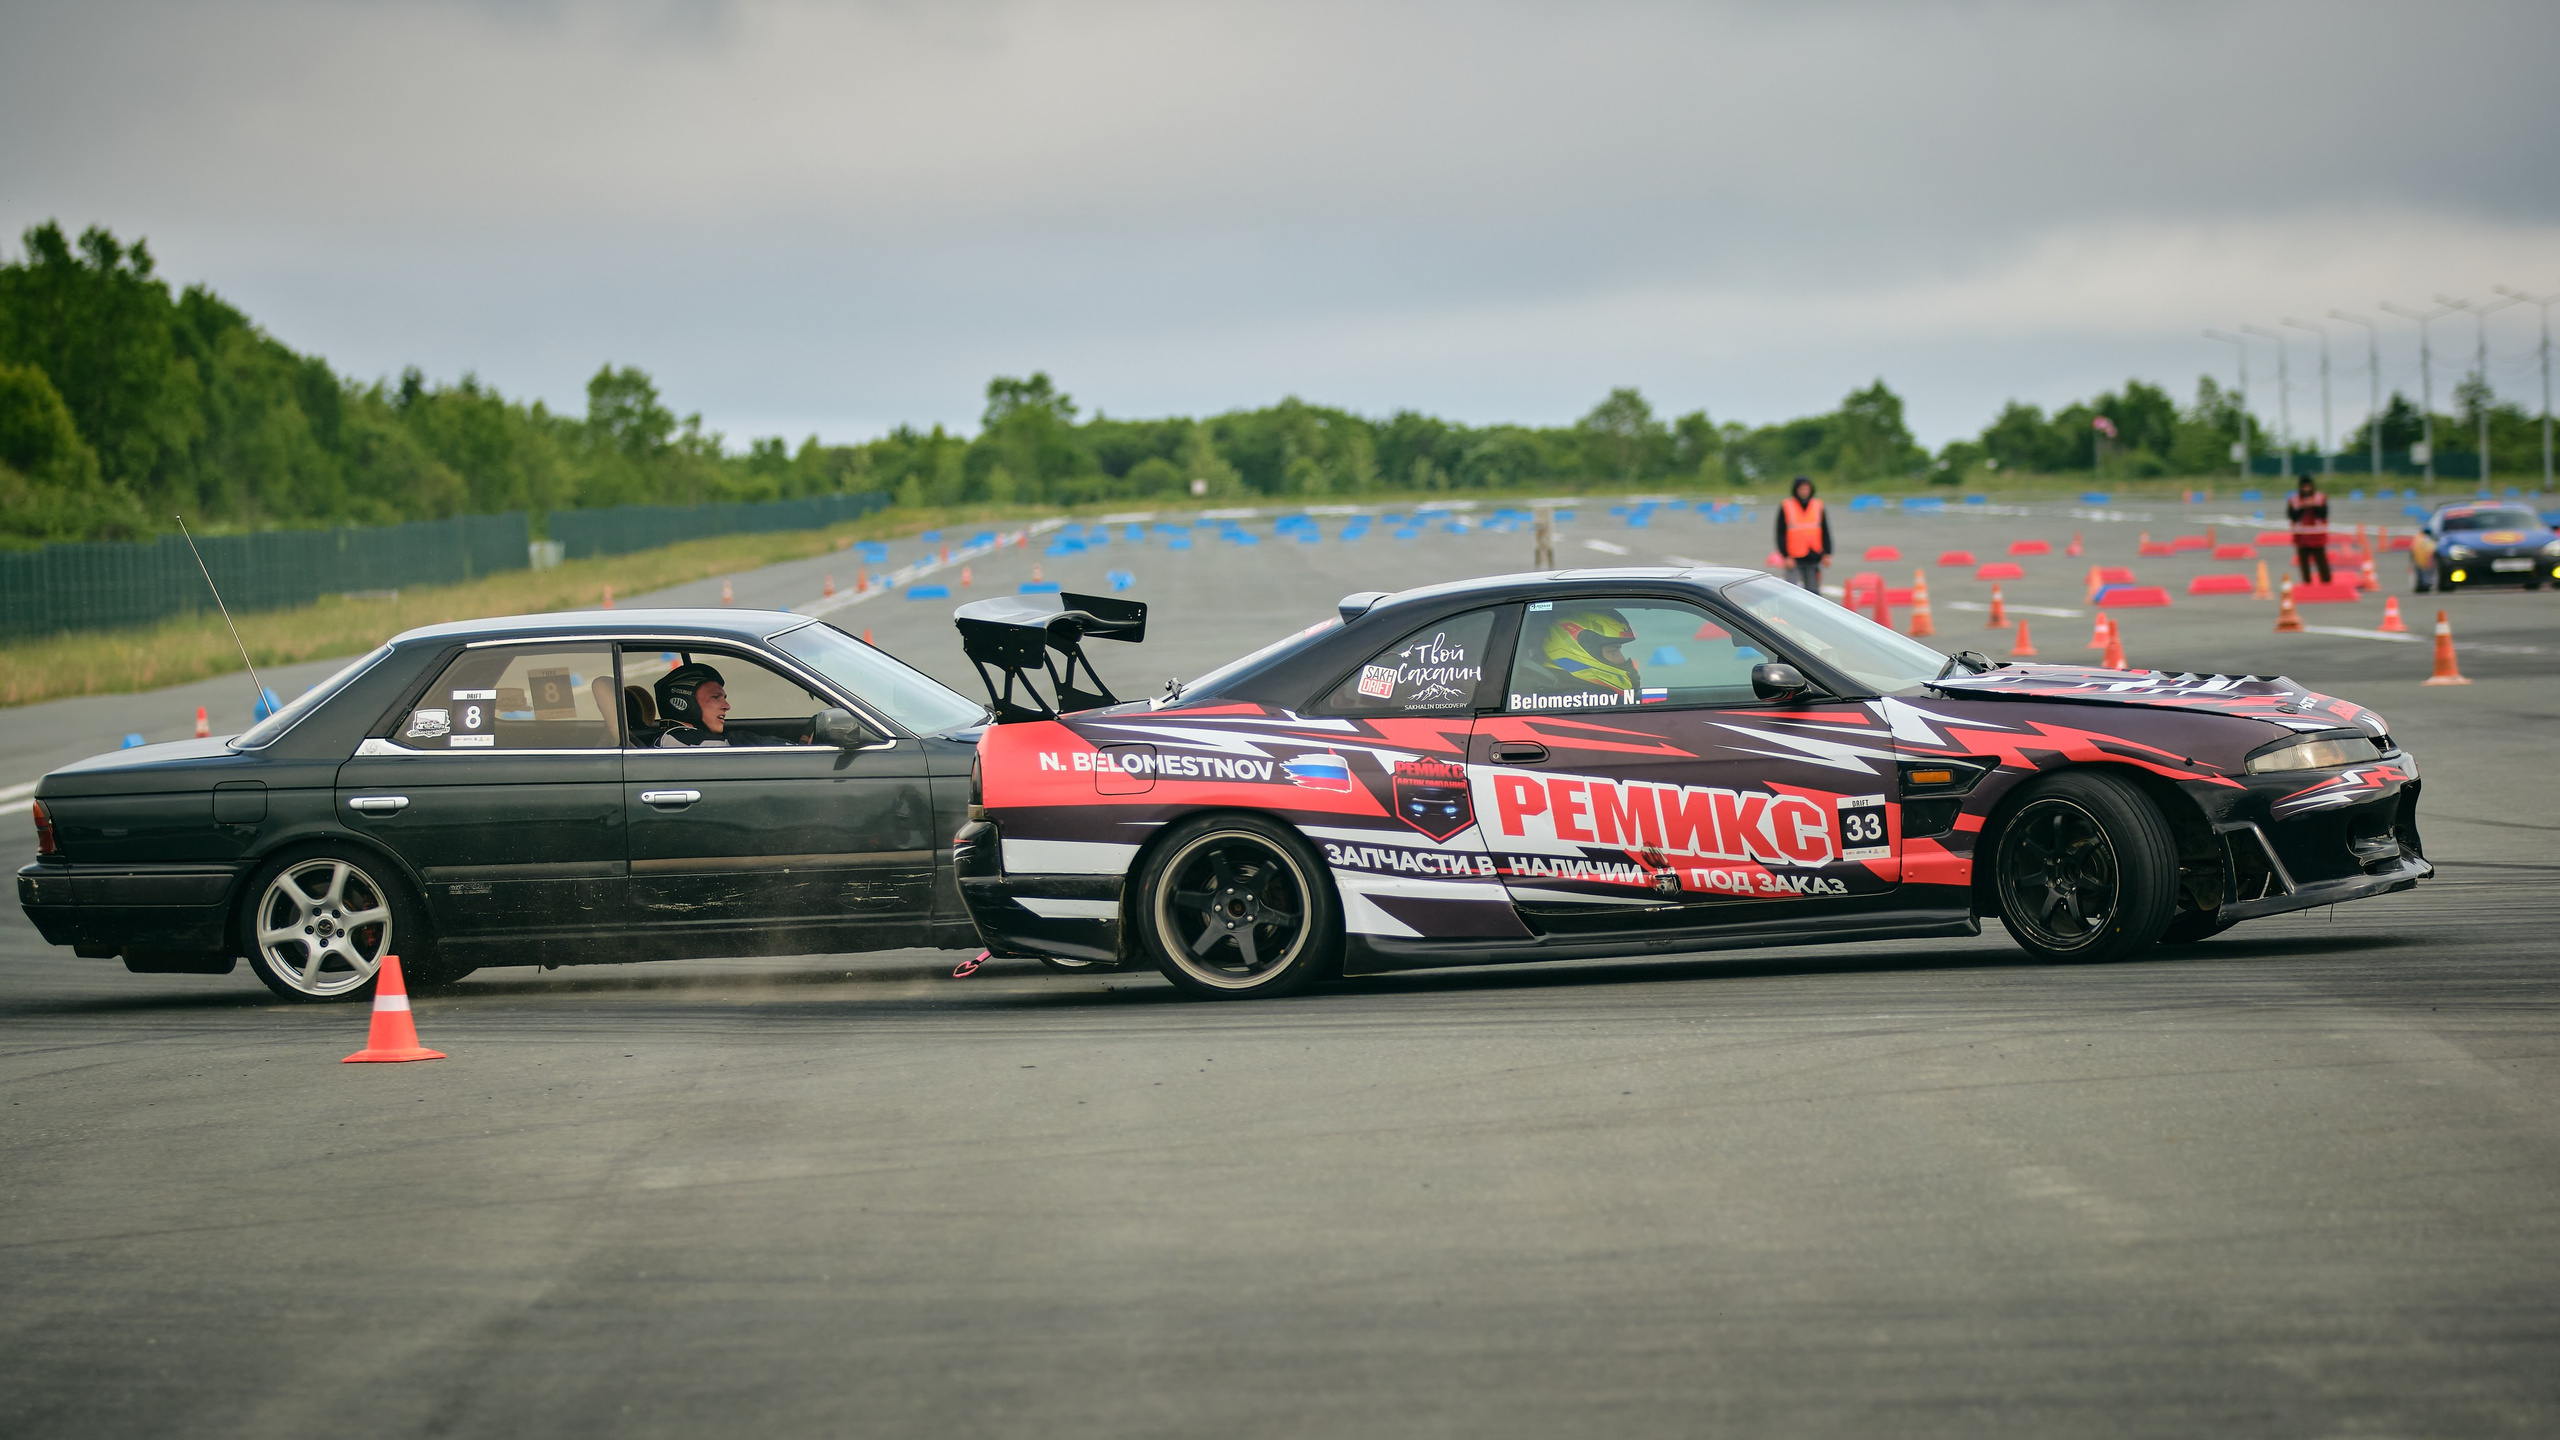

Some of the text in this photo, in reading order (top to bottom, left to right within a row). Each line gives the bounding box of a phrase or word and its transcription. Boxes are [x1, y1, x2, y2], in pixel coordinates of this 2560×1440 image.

[1415, 632, 1464, 664] Твой
[1366, 667, 1396, 682] SAKH
[1398, 663, 1481, 686] Сахалин
[1362, 680, 1393, 696] DRIFT
[1511, 688, 1641, 710] Belomestnov N.
[466, 705, 481, 729] 8
[1435, 702, 1467, 710] DISCOVERY
[1039, 752, 1274, 781] N. BELOMESTNOV
[1394, 761, 1464, 779] РЕМИКС
[1852, 799, 1869, 807] DRIFT
[1492, 774, 1831, 866] РЕМИКС
[1846, 813, 1882, 841] 33
[1324, 844, 1849, 895] ЗАПЧАСТИ В НАЛИЧИИ ПОД ЗАКАЗ
